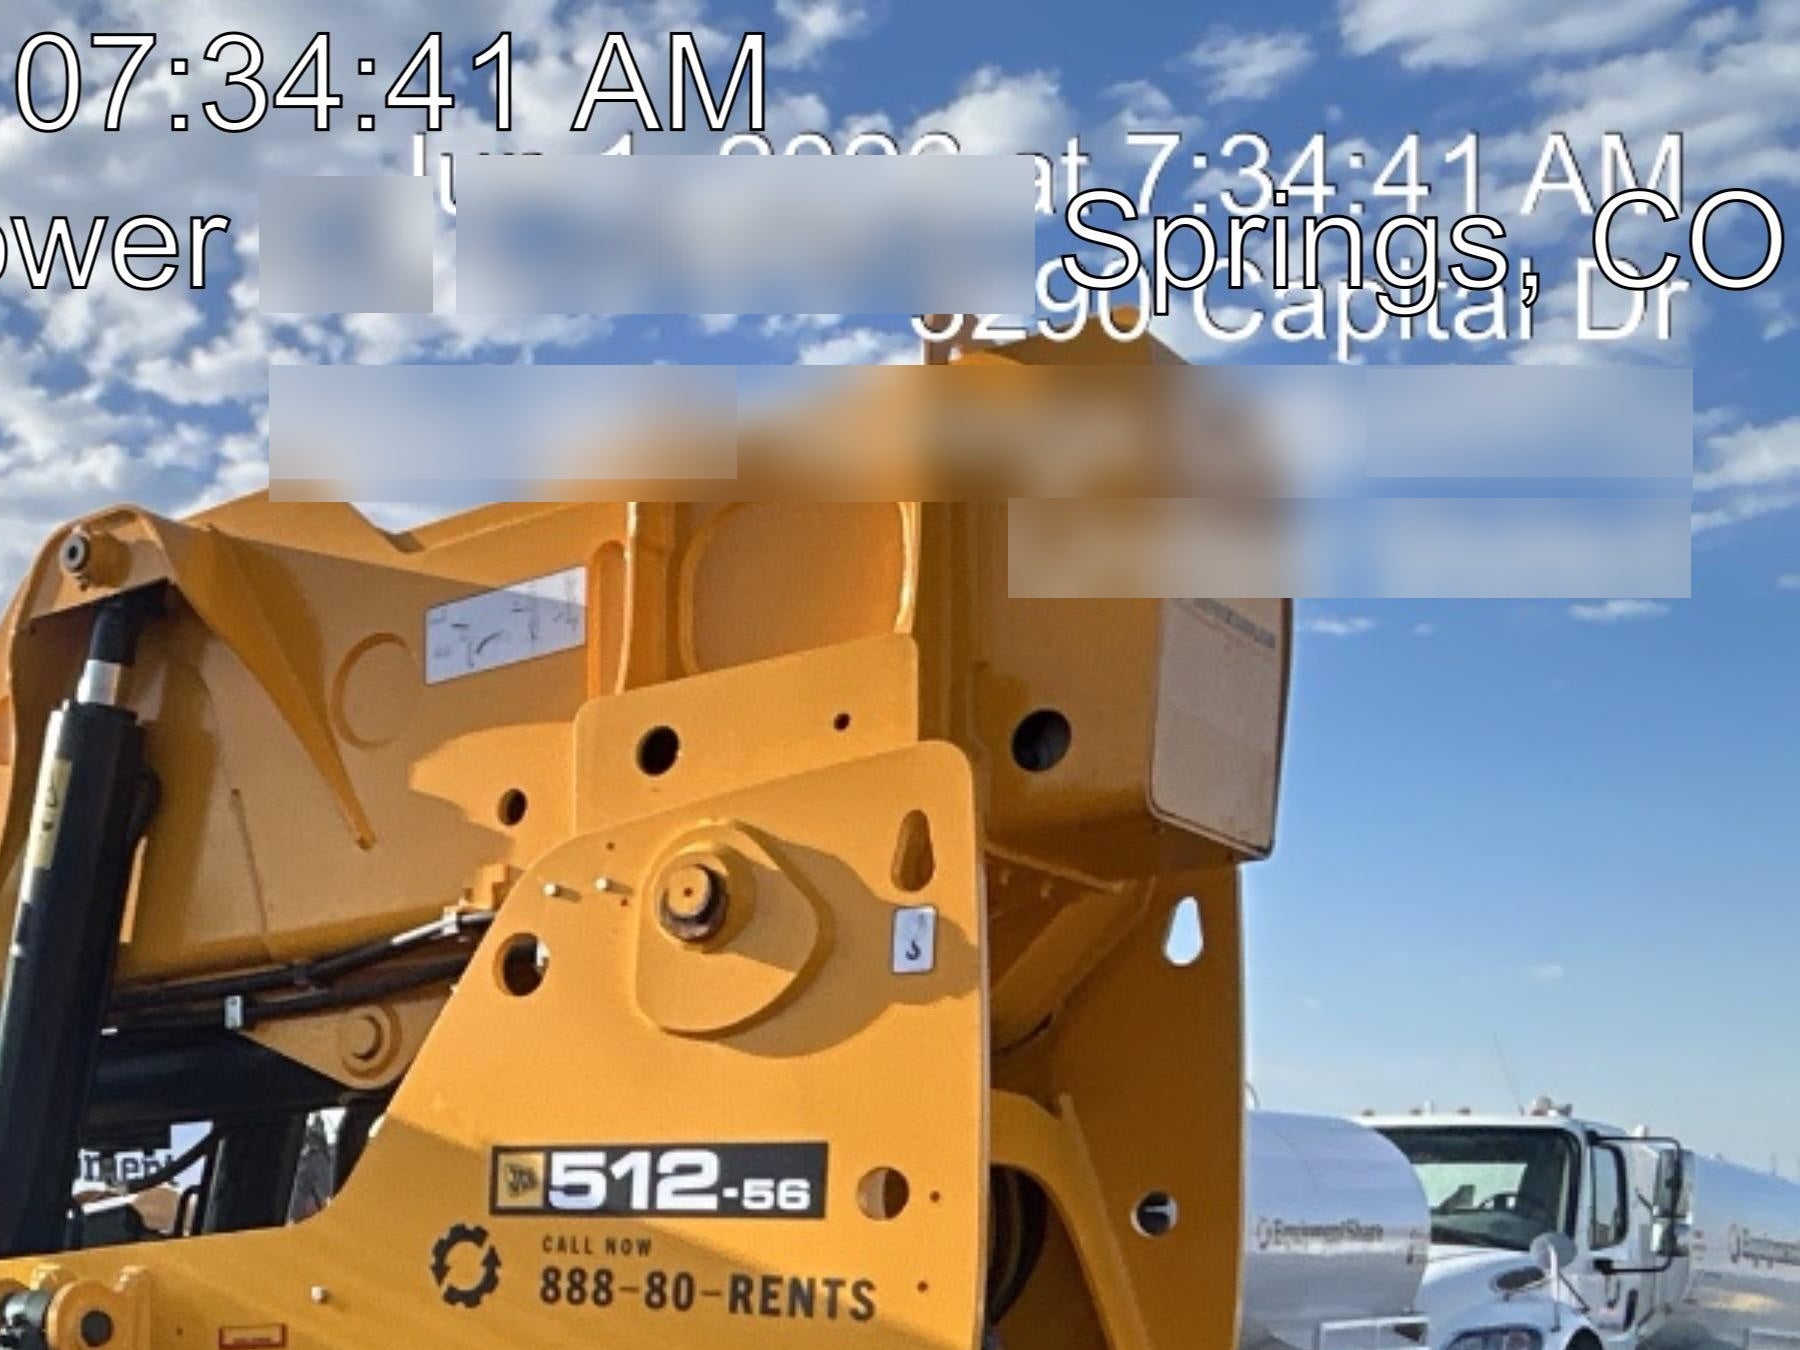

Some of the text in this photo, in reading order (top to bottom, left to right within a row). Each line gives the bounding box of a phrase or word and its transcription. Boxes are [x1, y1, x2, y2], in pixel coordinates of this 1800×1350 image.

[548, 1148, 811, 1211] 512-56
[541, 1235, 653, 1257] CALL NOW
[539, 1265, 877, 1323] 888-80-RENTS
